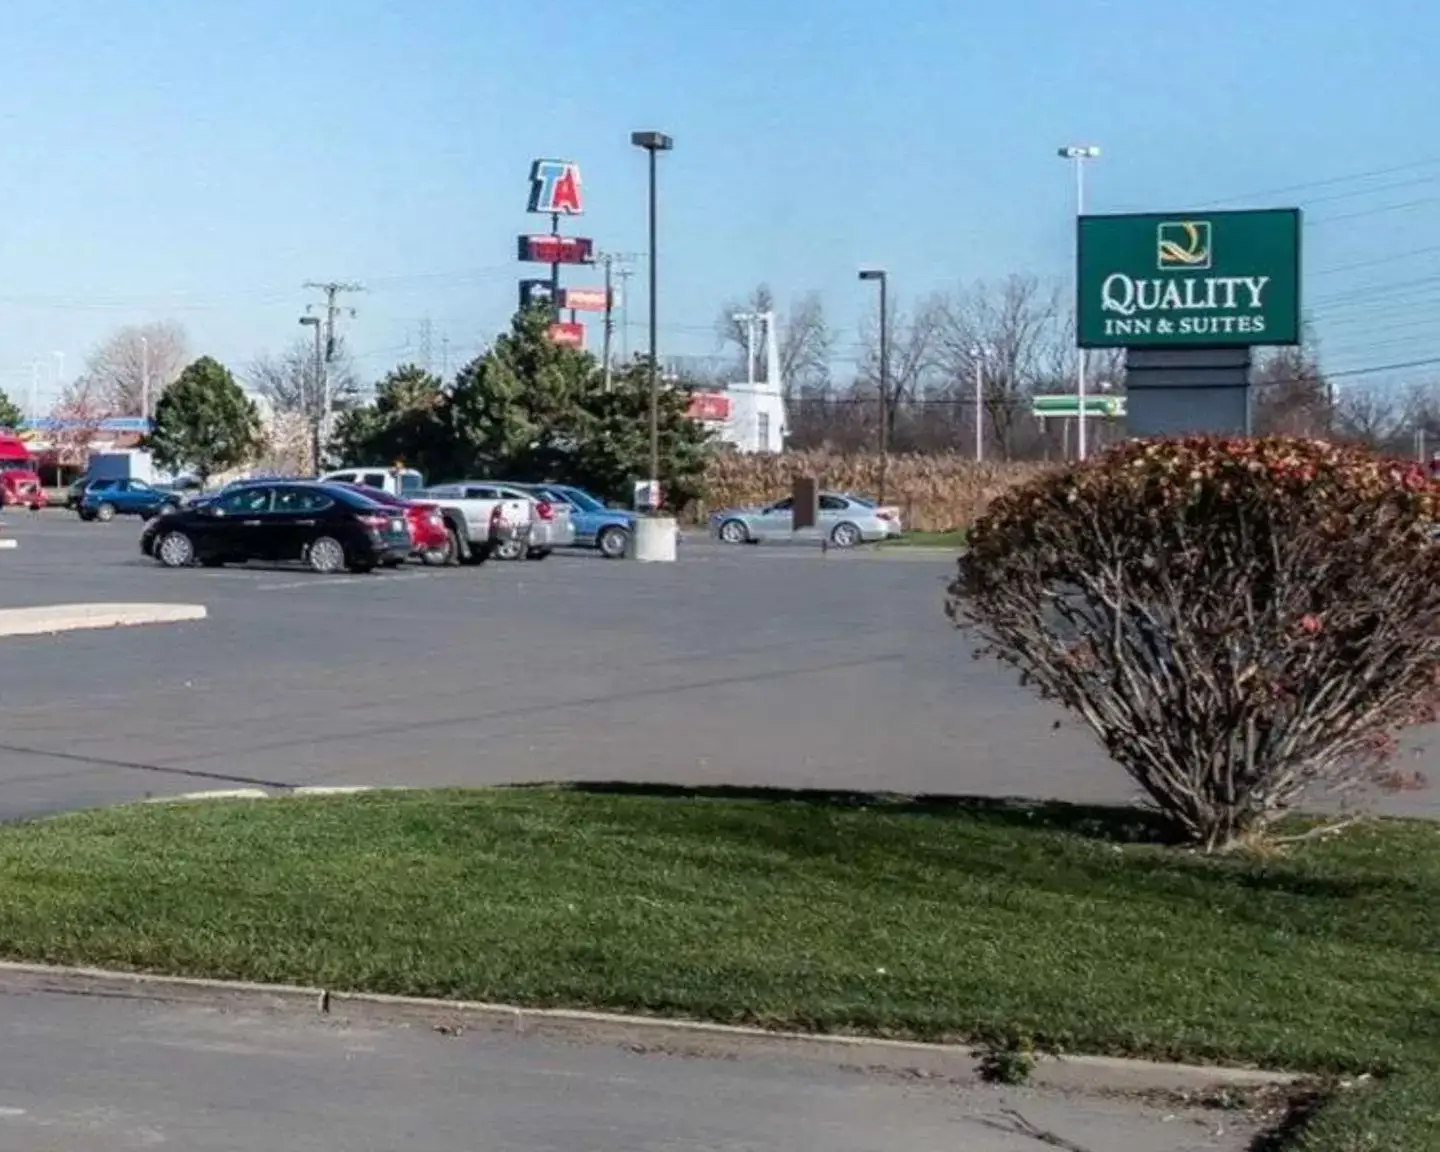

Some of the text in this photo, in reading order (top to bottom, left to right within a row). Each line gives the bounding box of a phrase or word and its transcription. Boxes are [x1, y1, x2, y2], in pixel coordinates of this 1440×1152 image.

[530, 160, 583, 213] TA
[1101, 273, 1269, 315] QUALITY
[1105, 316, 1265, 335] INN & SUITES
